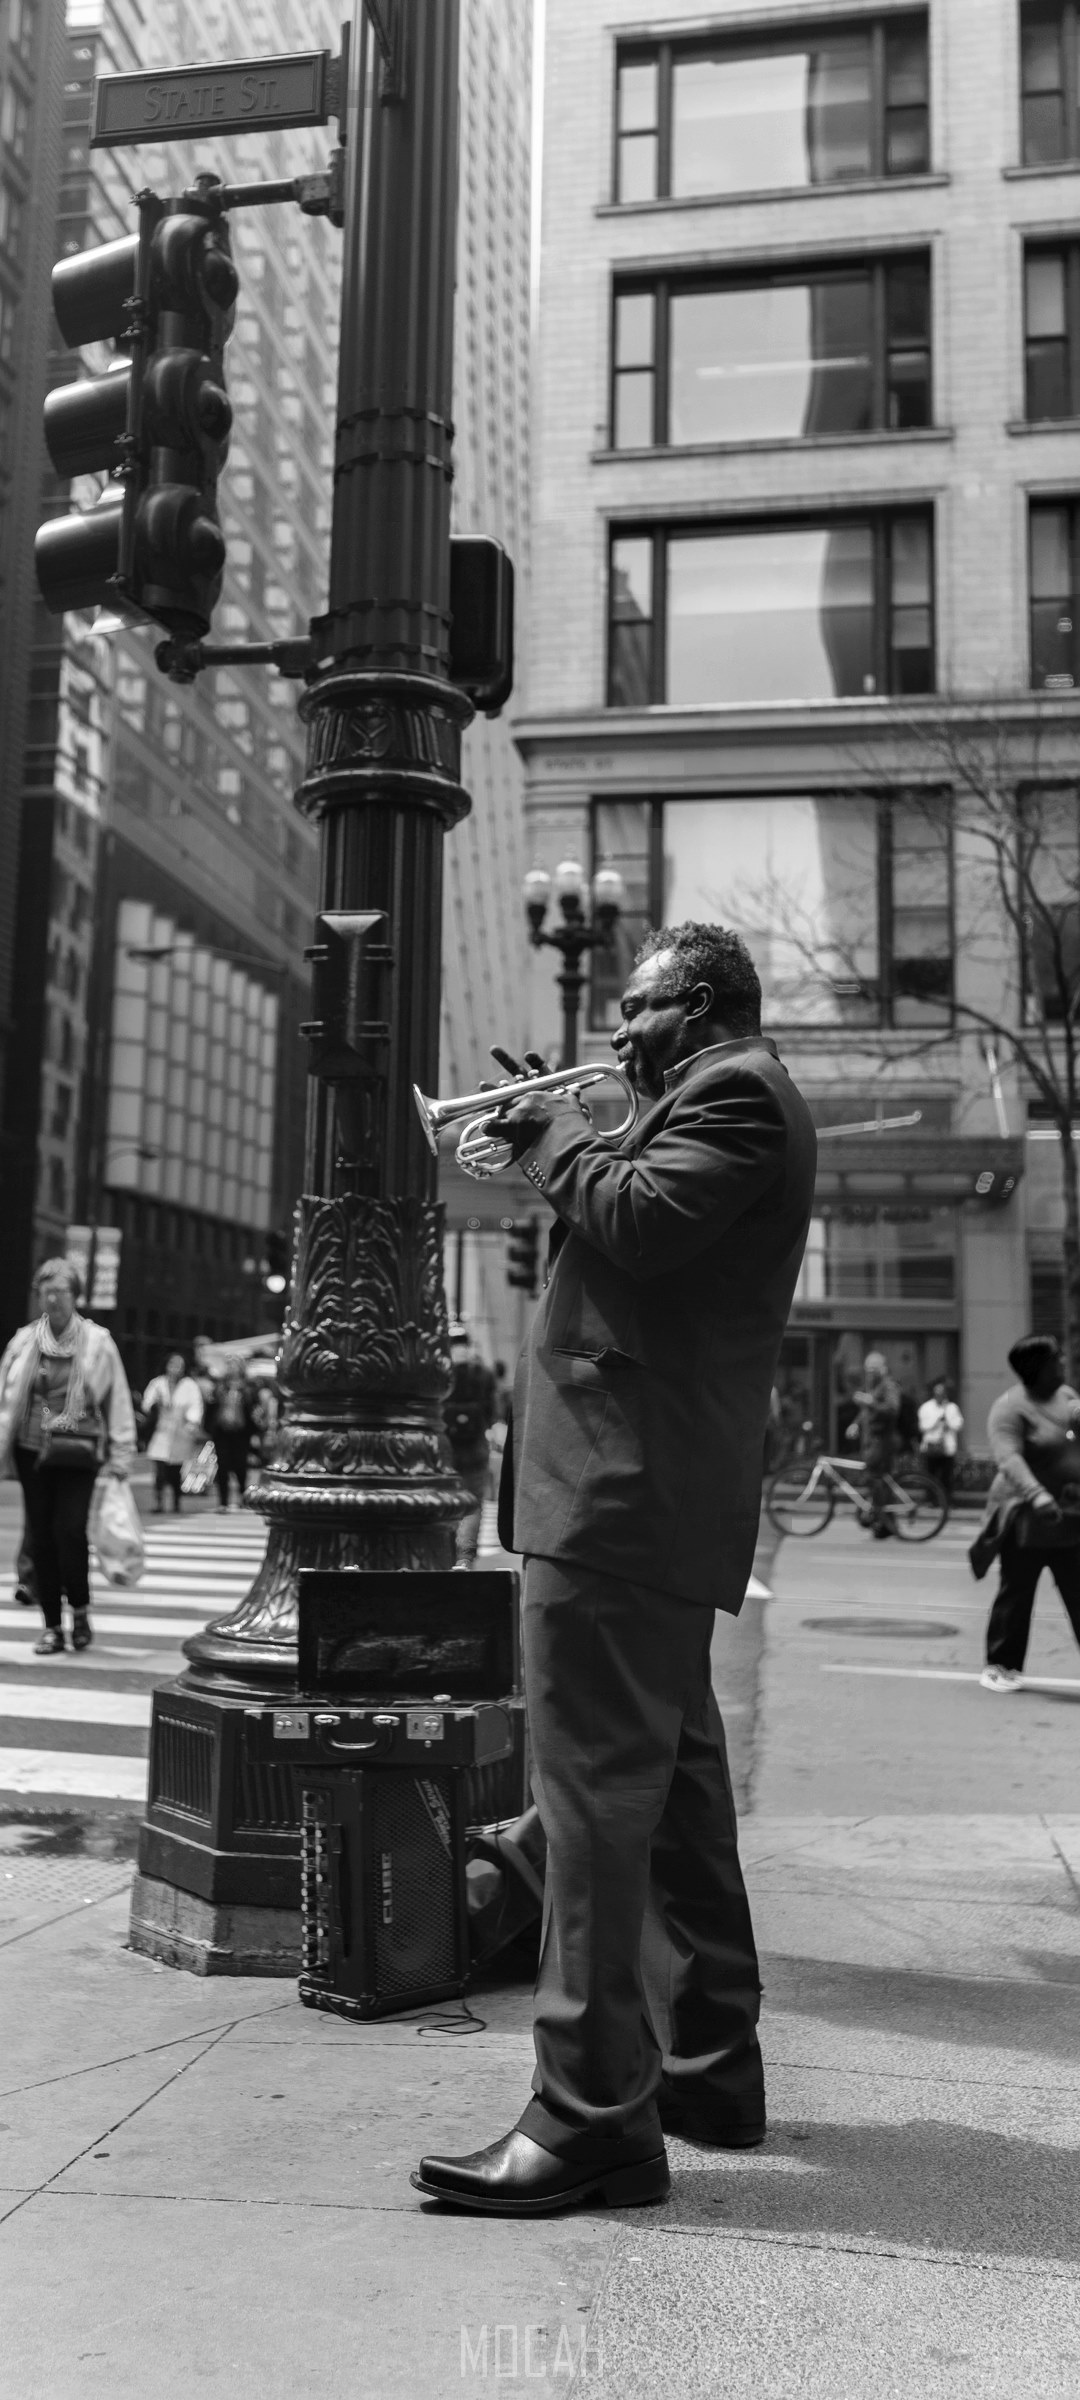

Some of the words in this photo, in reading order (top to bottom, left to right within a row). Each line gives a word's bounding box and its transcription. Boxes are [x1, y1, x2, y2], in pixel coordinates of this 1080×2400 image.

[144, 84, 225, 122] STATE
[240, 74, 280, 112] ST.
[381, 1853, 393, 1925] CUBE
